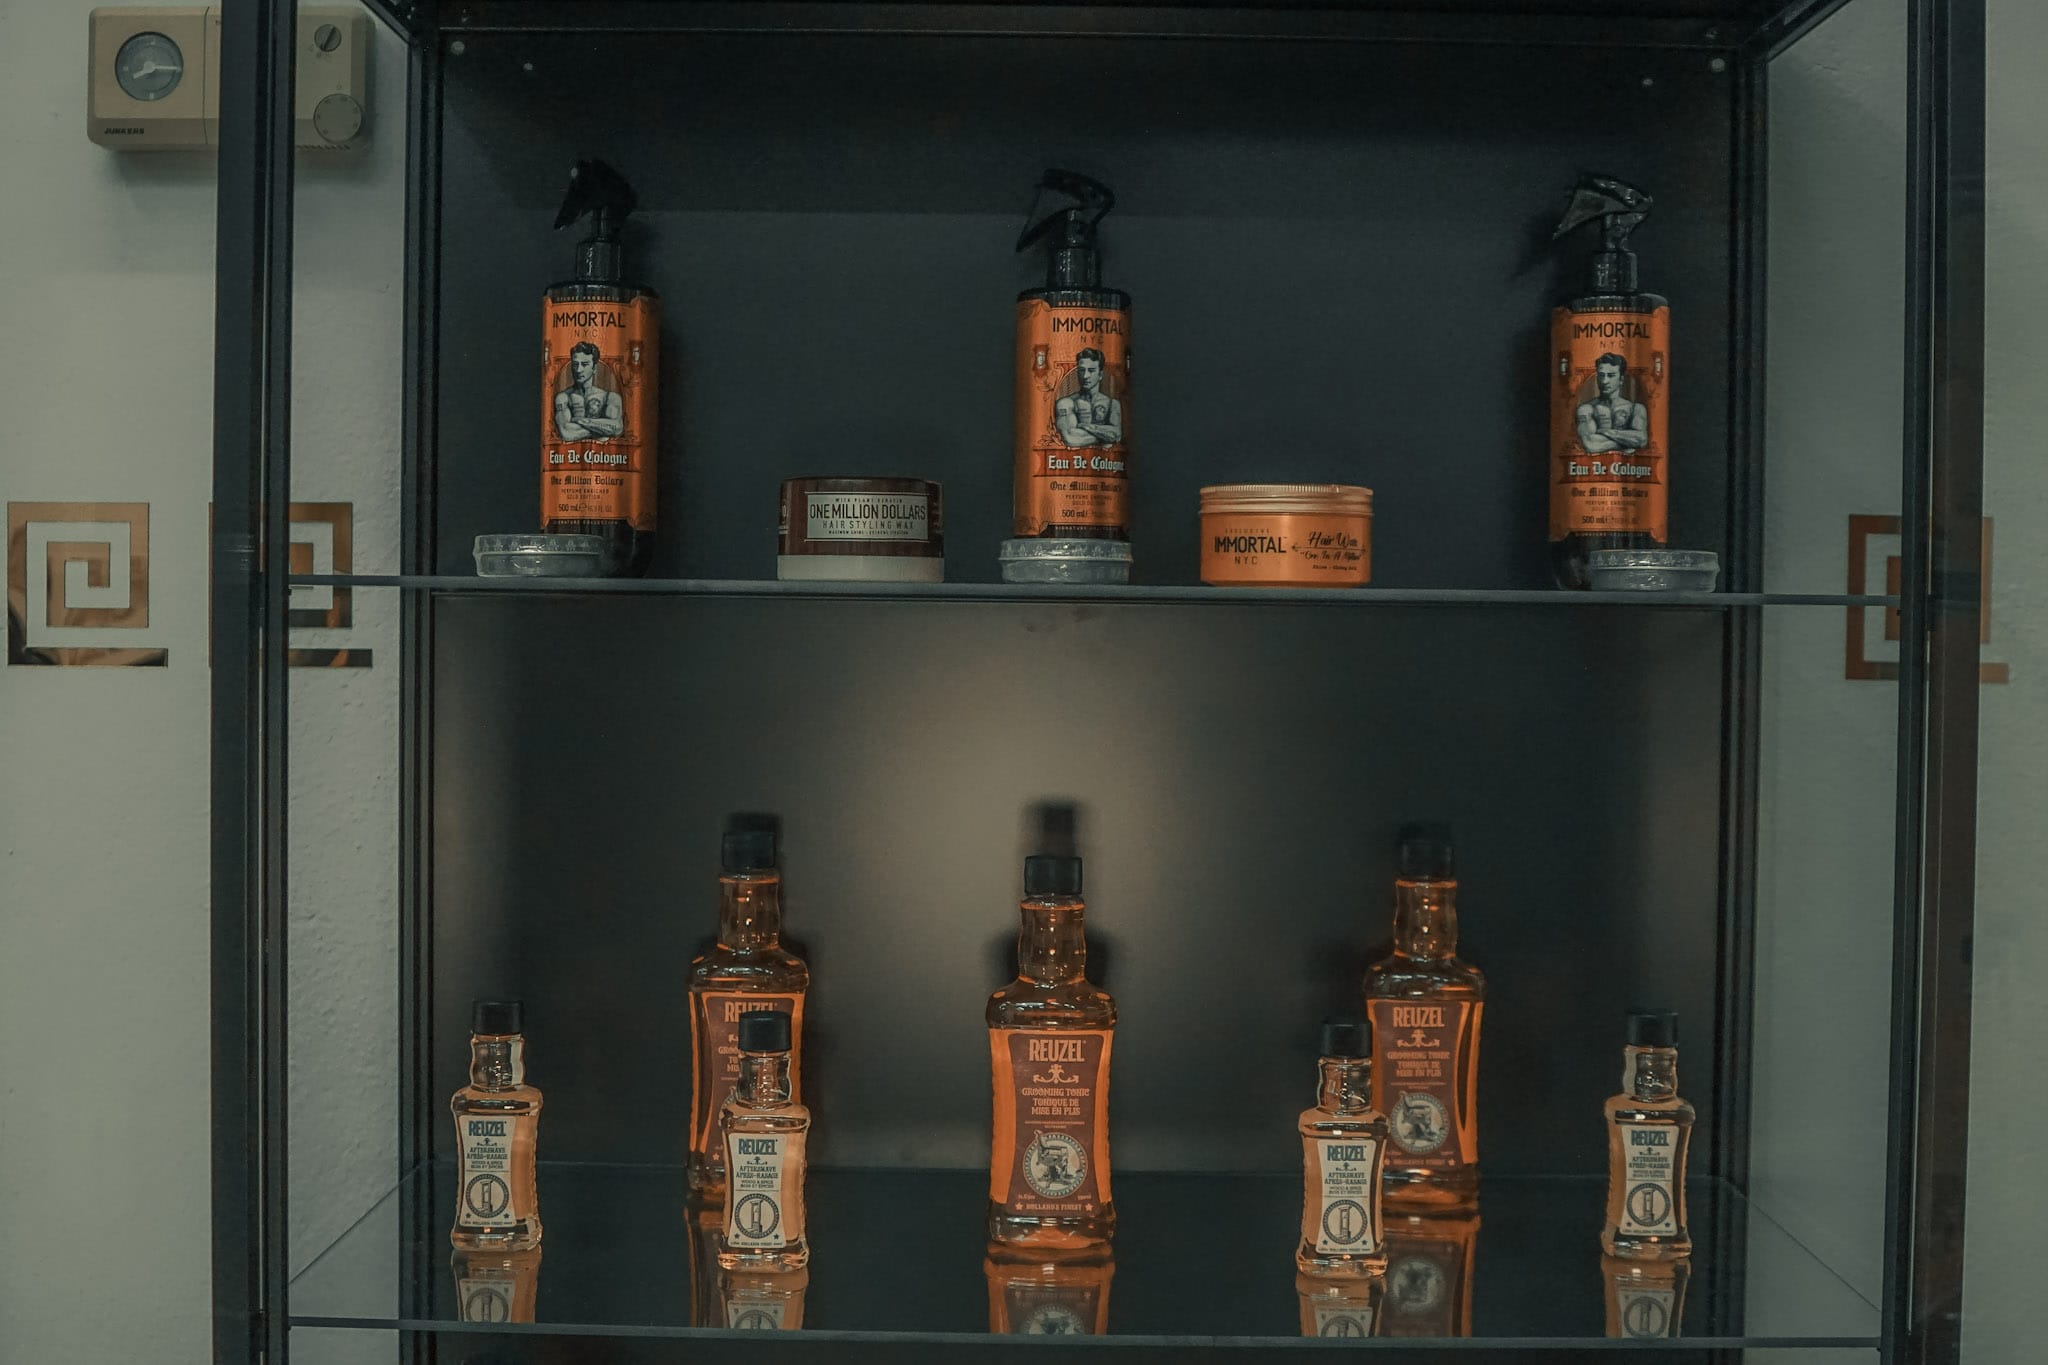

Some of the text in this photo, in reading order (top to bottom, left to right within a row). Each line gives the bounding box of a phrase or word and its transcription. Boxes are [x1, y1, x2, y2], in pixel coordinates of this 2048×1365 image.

[553, 312, 626, 328] IMMORTAL
[1053, 317, 1123, 335] IMMORTAL
[574, 330, 598, 338] NYC
[1574, 323, 1651, 339] IMMORTAL
[549, 450, 628, 466] Eau De Cologne
[1048, 456, 1069, 470] Eau
[1073, 456, 1087, 470] De
[1569, 462, 1651, 478] Eau De Cologne
[564, 475, 592, 485] Million
[594, 475, 624, 486] Dollars
[1050, 481, 1066, 490] One
[1590, 487, 1619, 497] Million
[558, 504, 569, 512] 500
[810, 504, 926, 520] ONE MILLION DOLLARS
[1062, 510, 1075, 518] 500
[823, 521, 845, 529] HAIR
[849, 521, 892, 529] STYLING
[1215, 536, 1287, 553] IMMORTAL
[1308, 531, 1334, 548] Hair
[1235, 557, 1258, 565] NYC
[1393, 1007, 1446, 1028] REUZEL
[1029, 1039, 1085, 1062] REUZEL
[1022, 1088, 1091, 1097] GROOMING TONIC
[1033, 1098, 1080, 1107] TONIQUE DE
[1031, 1107, 1081, 1116] MISE EN PLIS
[468, 1121, 506, 1136] REUZEL
[1632, 1131, 1669, 1146] REUZEL
[739, 1139, 777, 1155] REUZEL
[1327, 1145, 1366, 1161] REUZEL
